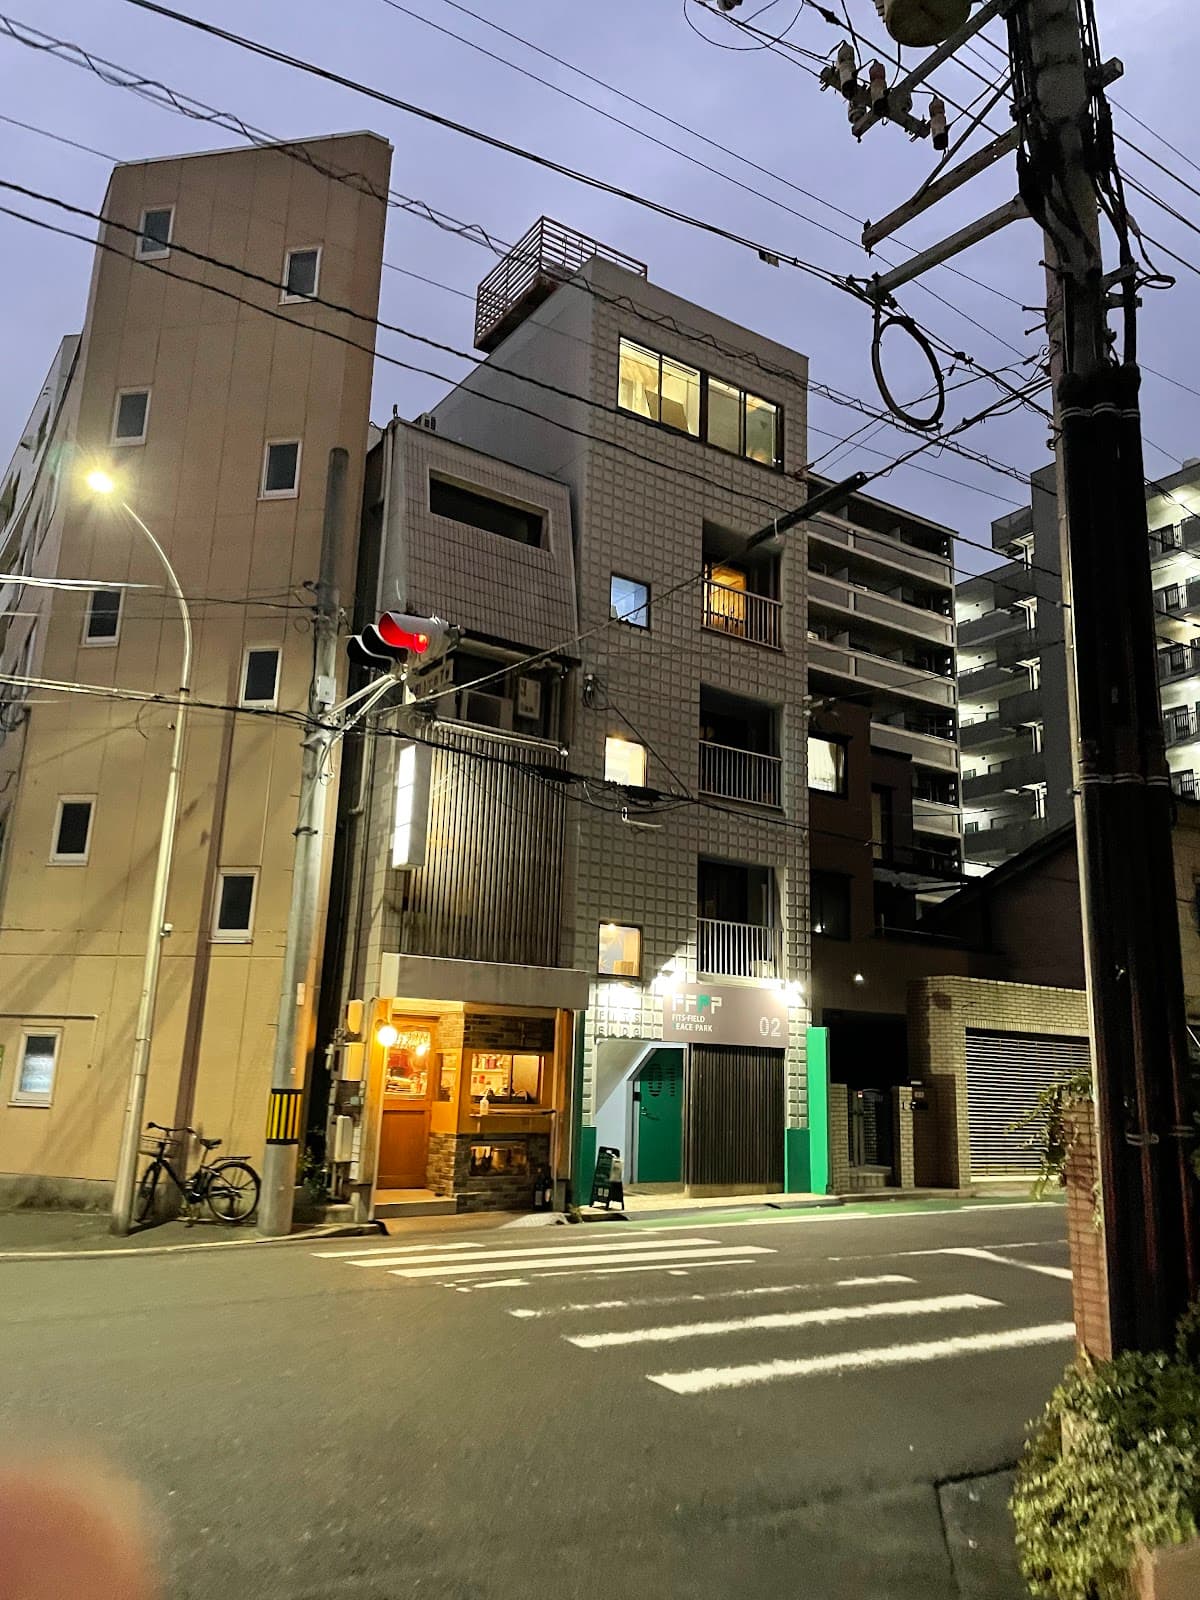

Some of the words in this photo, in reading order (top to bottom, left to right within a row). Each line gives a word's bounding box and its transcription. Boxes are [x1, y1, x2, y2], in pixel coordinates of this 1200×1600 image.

[599, 1010, 640, 1024] FITS
[672, 1014, 705, 1023] FITS-FIELD
[695, 1024, 713, 1032] PARK
[760, 1016, 782, 1037] 02
[648, 1063, 676, 1097] 01
